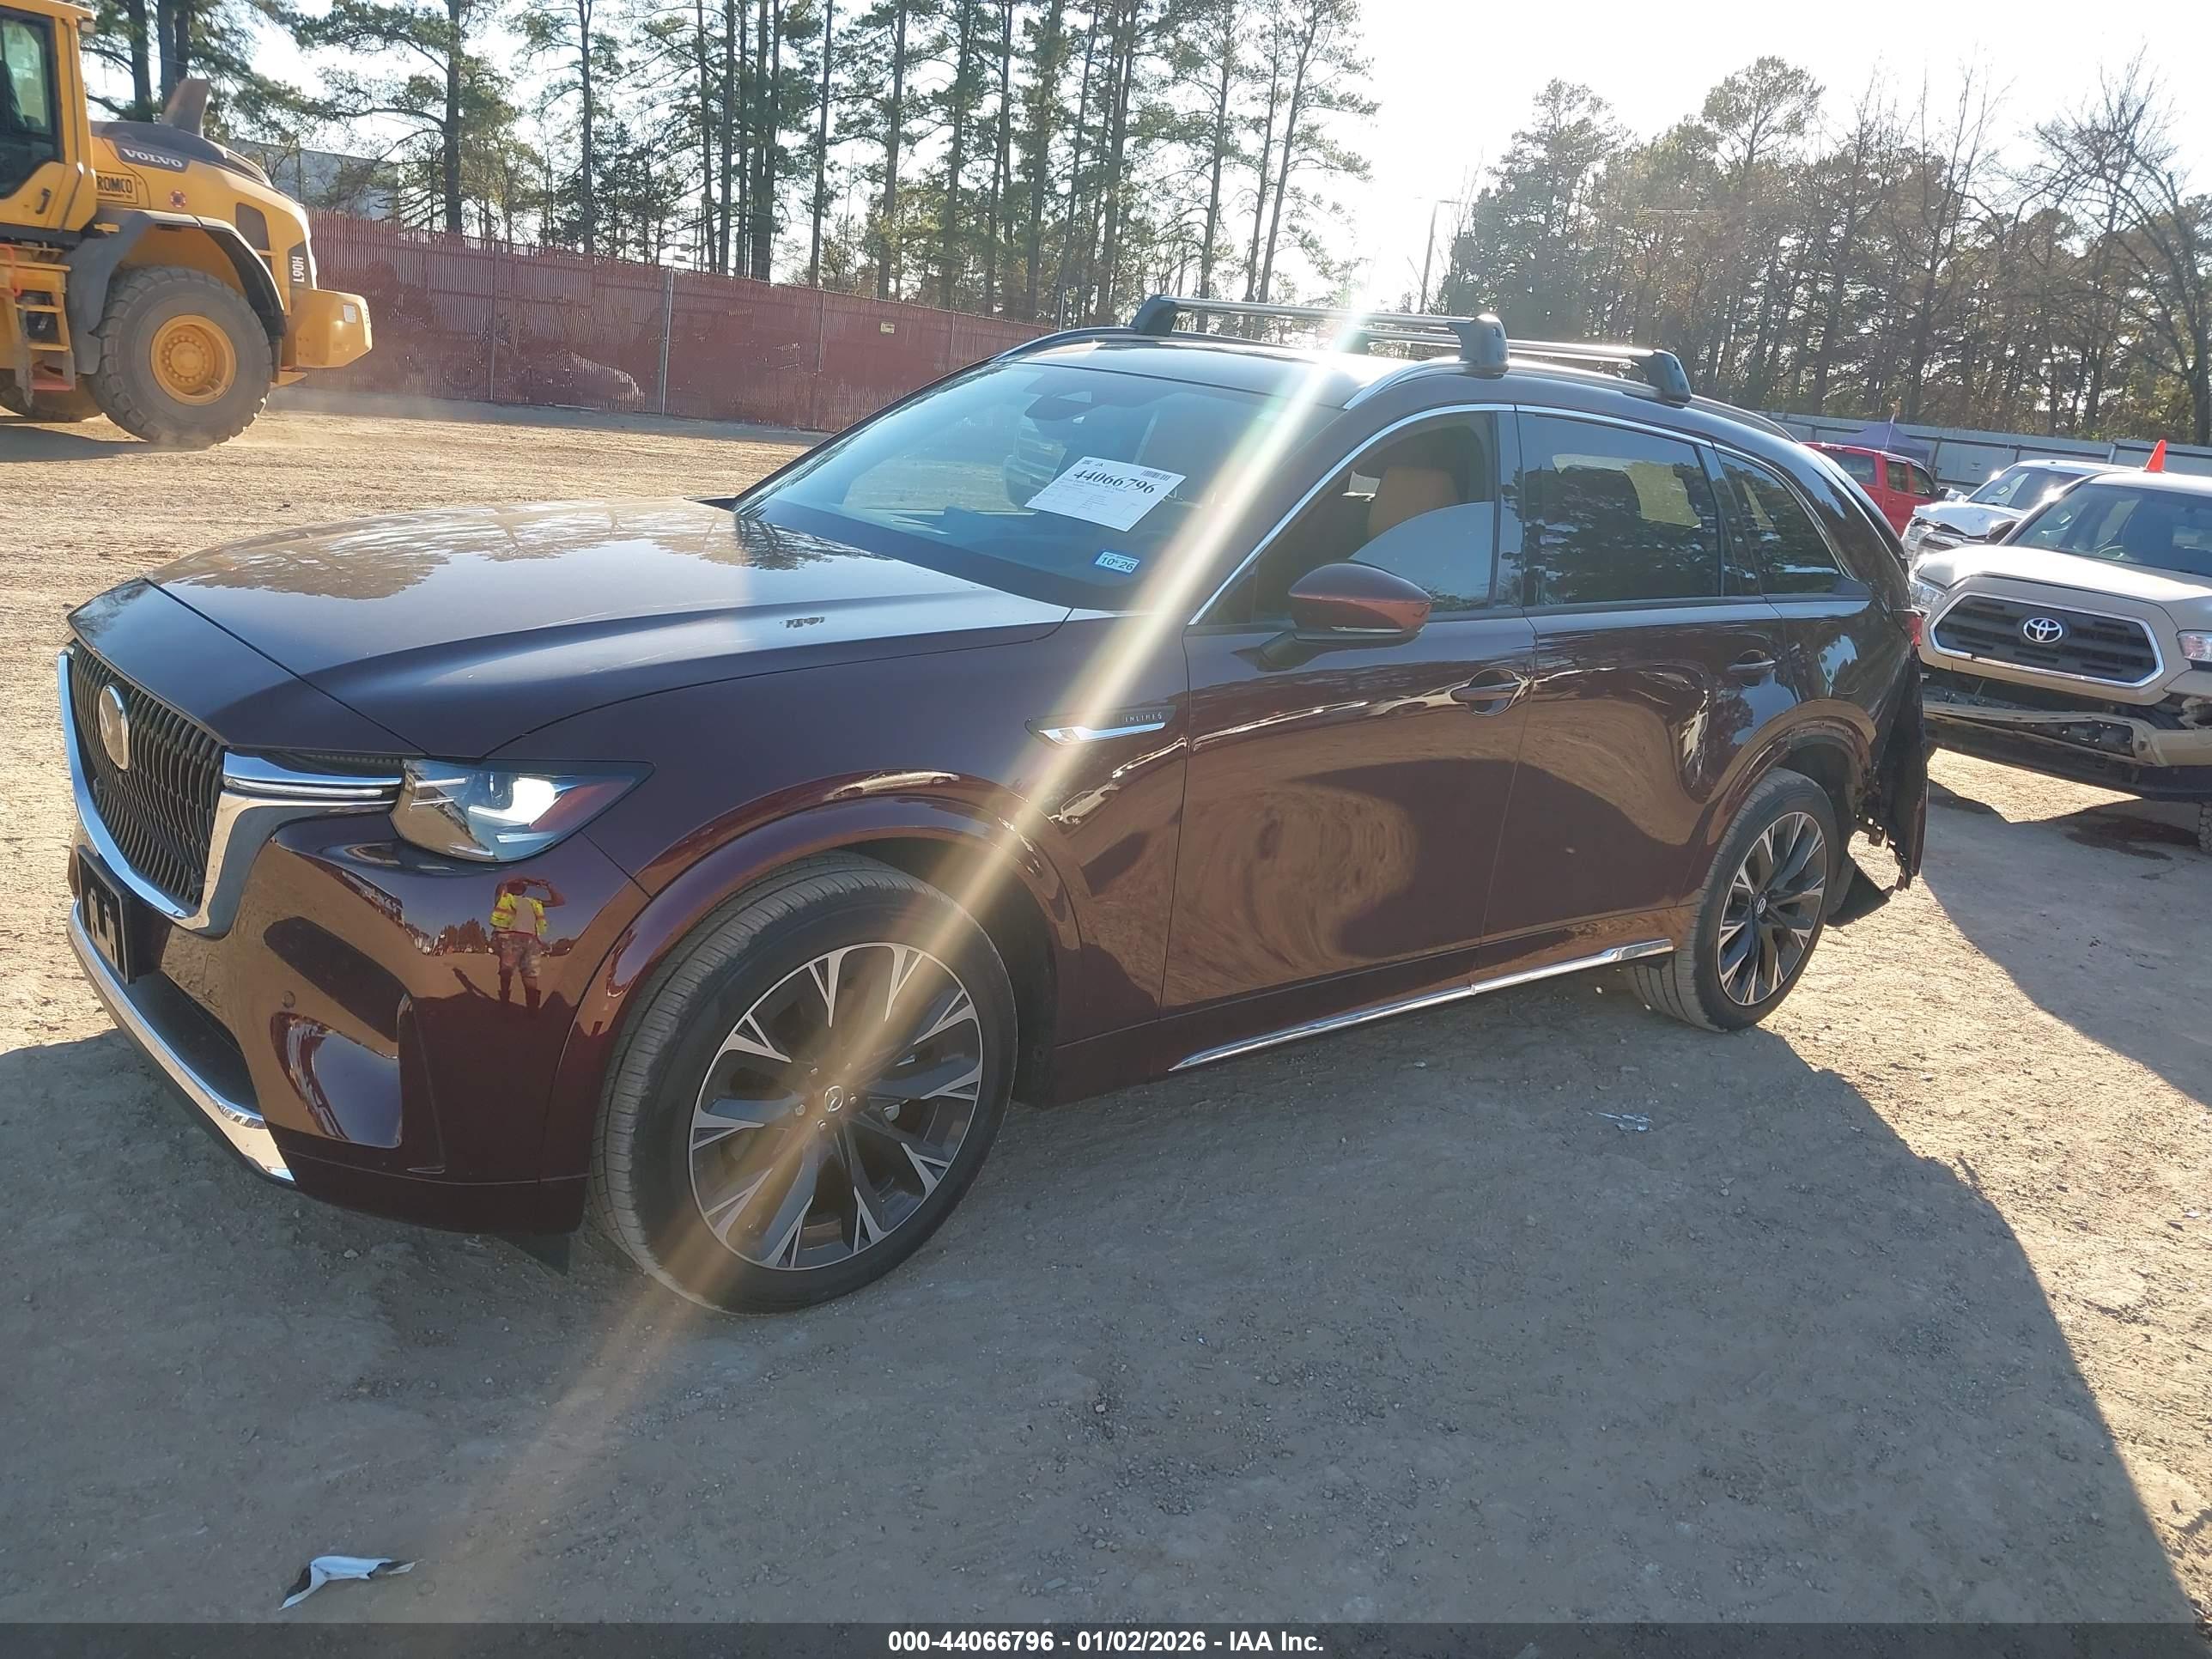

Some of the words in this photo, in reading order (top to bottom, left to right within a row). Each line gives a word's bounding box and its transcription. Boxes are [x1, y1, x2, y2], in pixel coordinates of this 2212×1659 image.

[121, 148, 183, 168] VOLVO
[96, 174, 134, 194] ROMCO
[292, 256, 305, 283] L90H
[1073, 469, 1161, 495] 44066796
